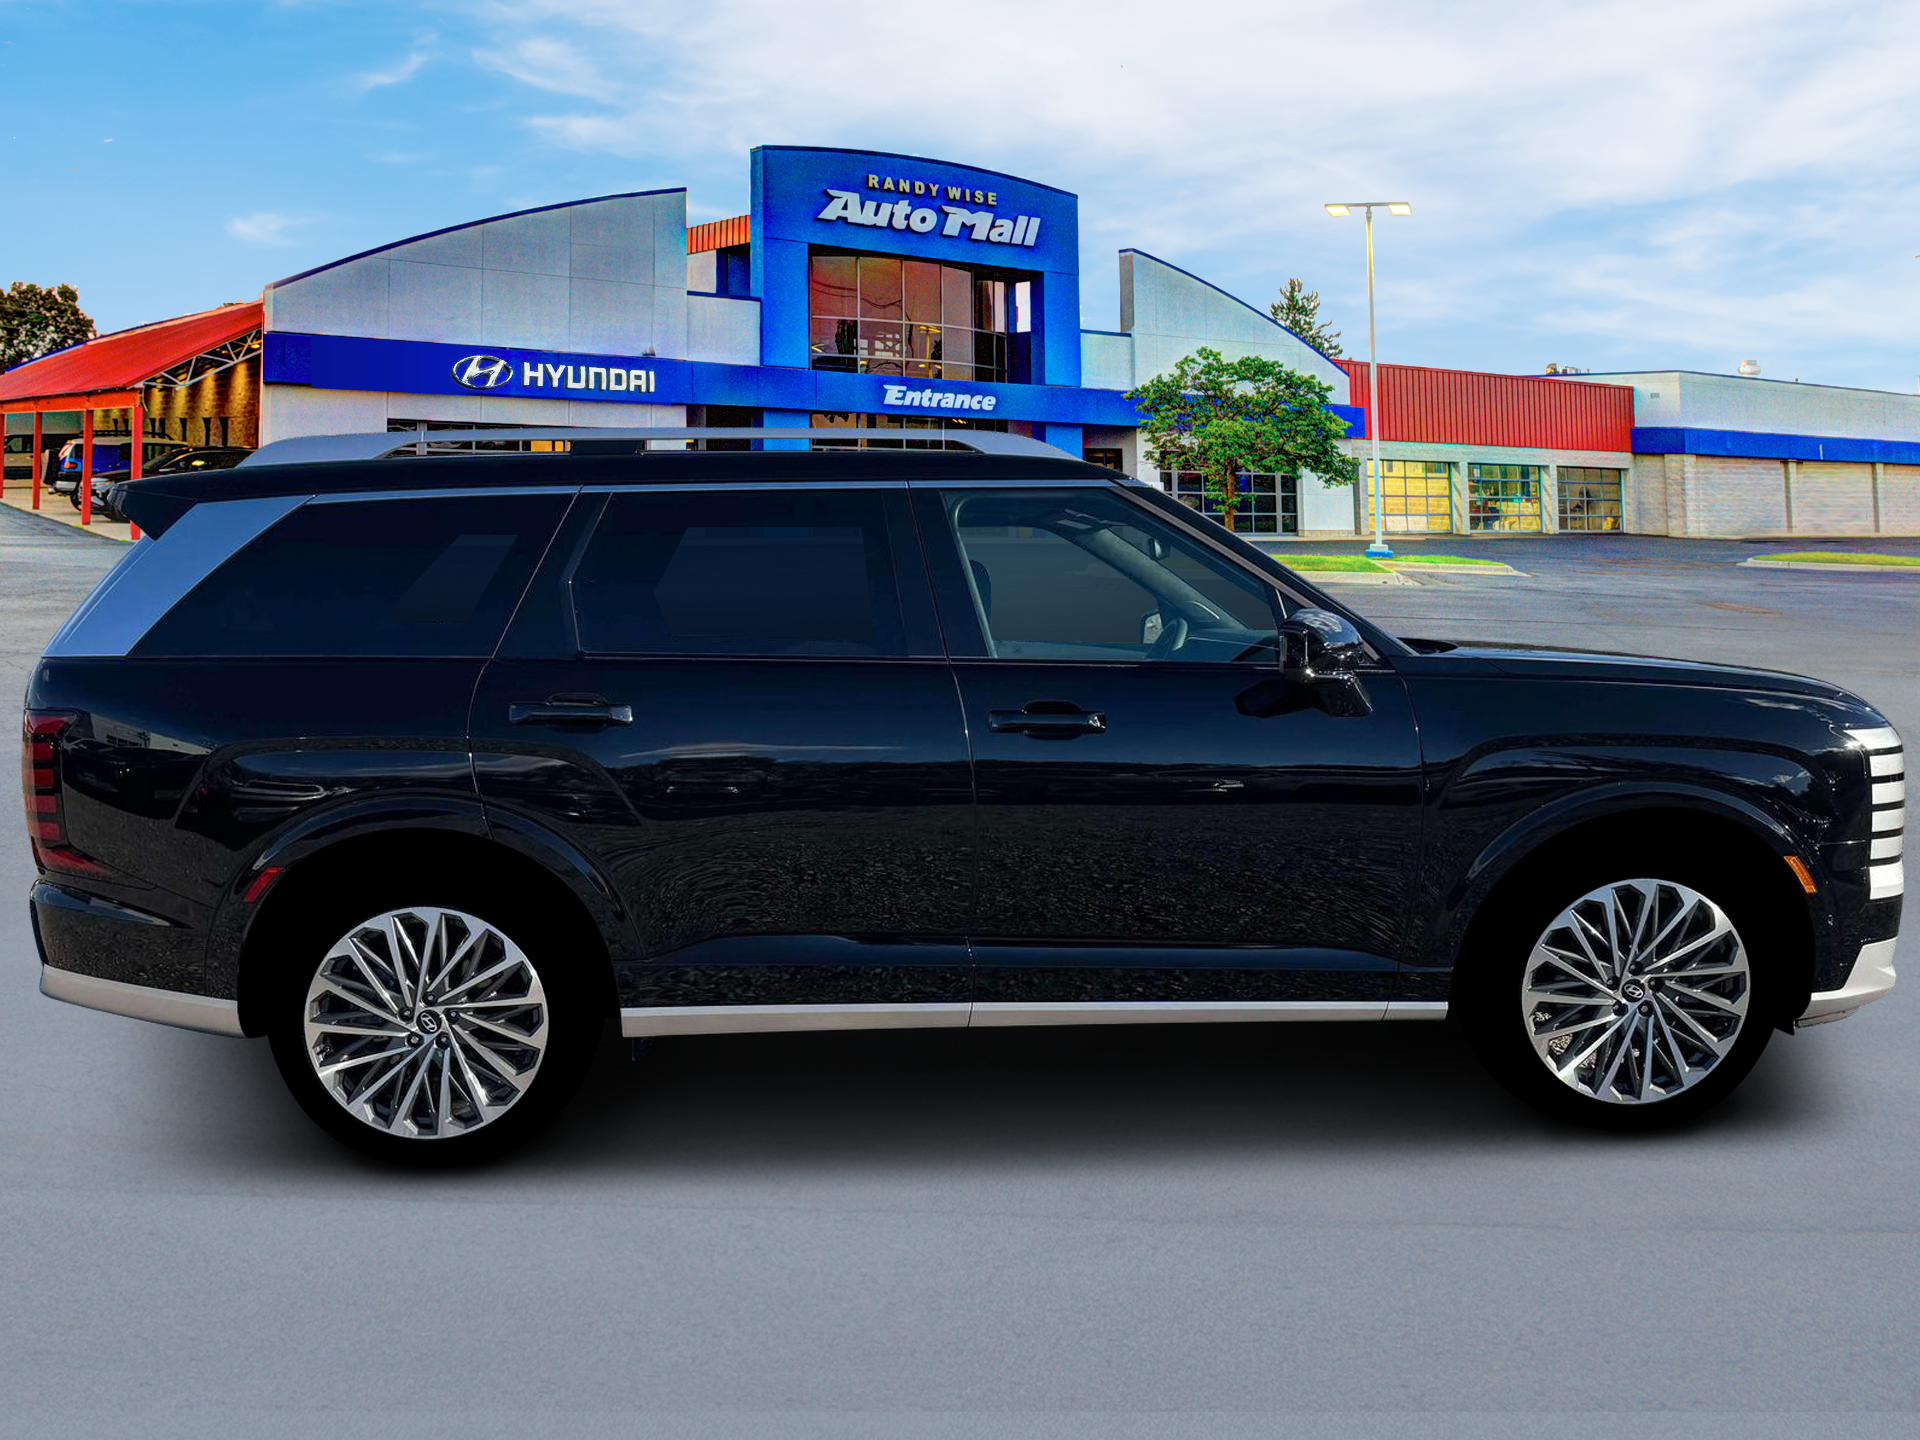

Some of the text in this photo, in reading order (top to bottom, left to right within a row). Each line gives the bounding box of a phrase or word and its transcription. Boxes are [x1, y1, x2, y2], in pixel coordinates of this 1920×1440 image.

[867, 174, 998, 206] RANDY WISE
[816, 188, 1041, 247] Auto Mall
[522, 362, 656, 393] HYUNDAI
[883, 384, 997, 412] Entrance
